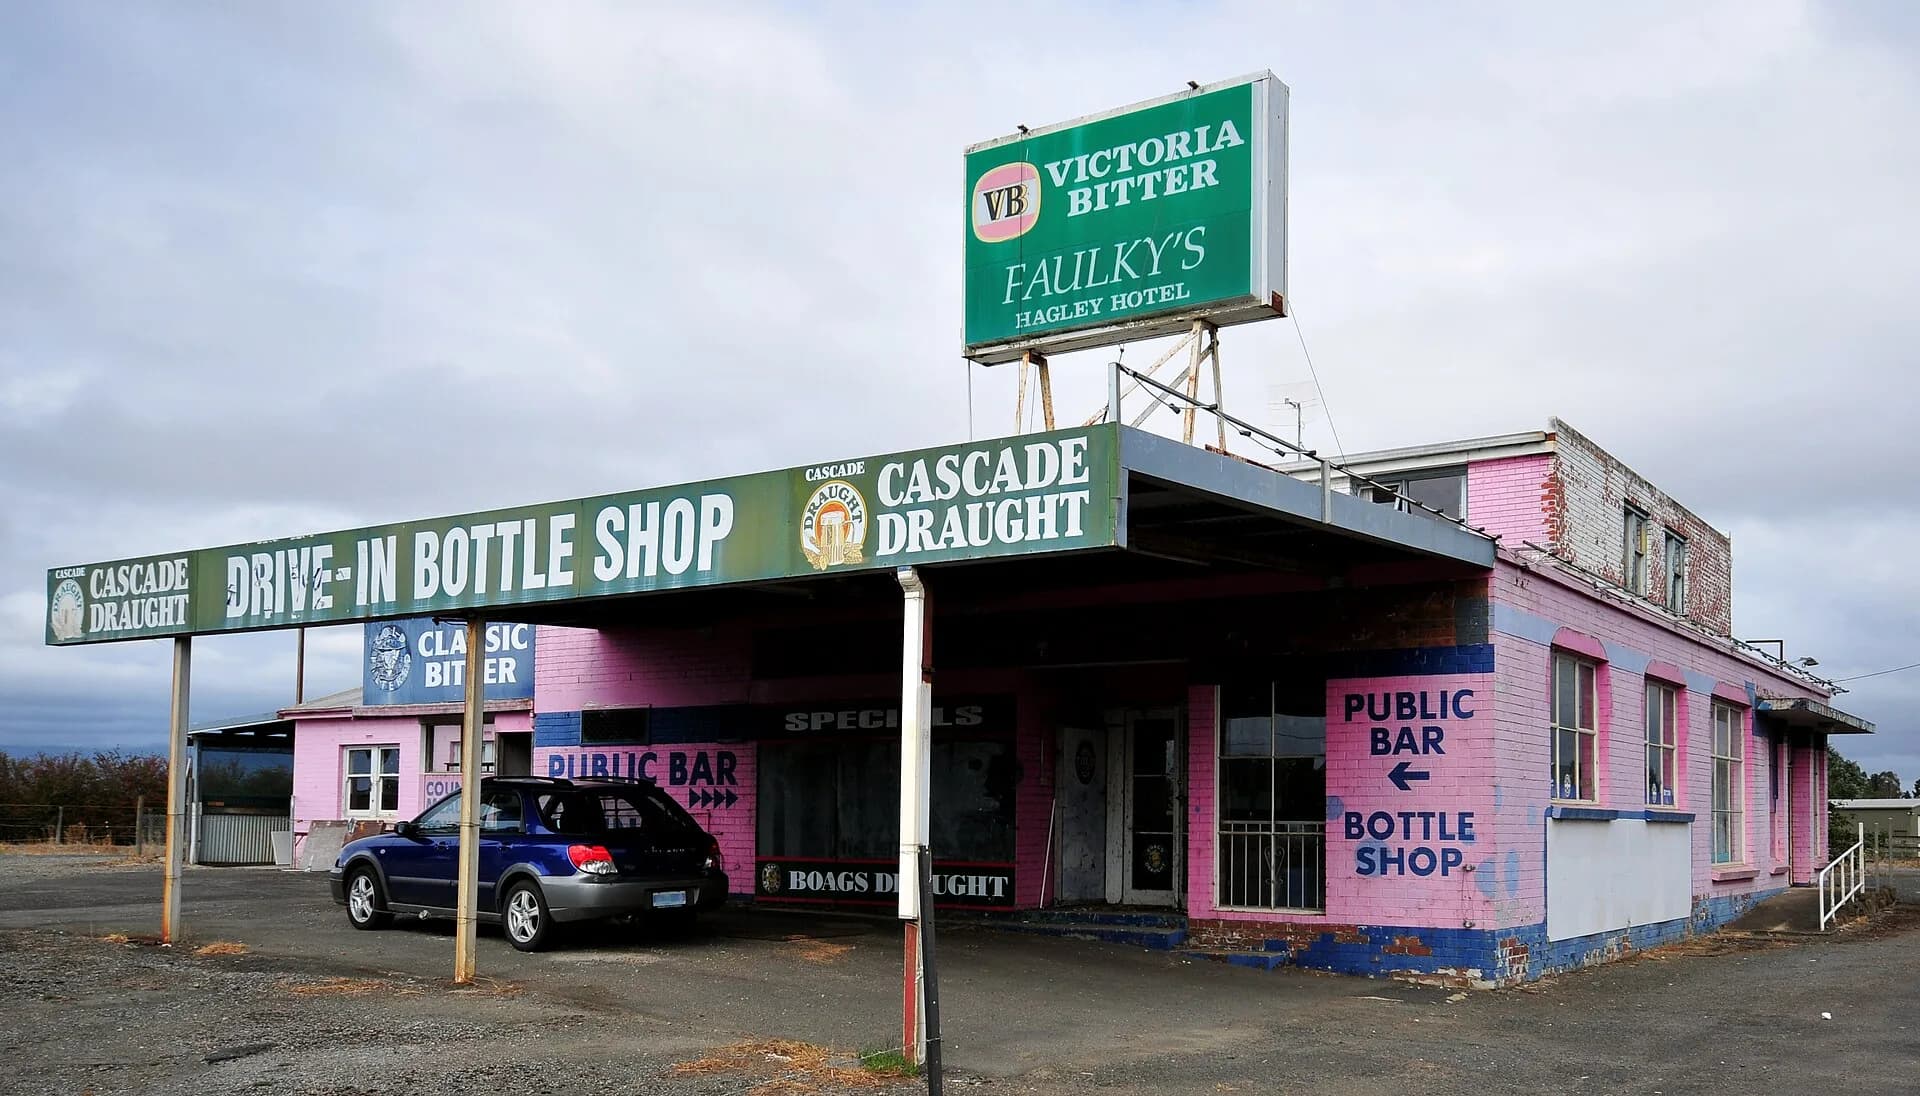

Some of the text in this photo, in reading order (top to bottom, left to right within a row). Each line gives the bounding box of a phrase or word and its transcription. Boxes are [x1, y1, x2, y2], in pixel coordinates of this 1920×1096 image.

[1044, 120, 1244, 188] VICTORIA
[983, 184, 1028, 221] VB
[1067, 160, 1219, 217] BITTER
[1002, 226, 1206, 305] FAULKY'S
[1016, 283, 1190, 329] HAGLEY HOTEL
[805, 461, 865, 482] CASCADE
[877, 436, 1089, 507] CASCADE
[804, 485, 862, 531] DRAUGHT
[876, 490, 1089, 556] DRAUGHT
[56, 567, 86, 578] CASCADE
[226, 494, 734, 618] DRIVE-IN BOTTLE SHOP
[90, 558, 189, 599] CASCADE
[89, 594, 189, 632] DRAUGHT
[418, 624, 529, 657] CLASIC
[425, 658, 517, 687] BITER
[785, 706, 983, 731] SPECILS
[1345, 689, 1474, 721] PUBLIC
[1371, 726, 1446, 755] BAR
[670, 751, 738, 785] BAR
[1345, 811, 1474, 841] BOTTLE
[1356, 847, 1463, 876] SHOP
[788, 871, 868, 892] BOAGS
[875, 873, 1008, 897] DUGHT
